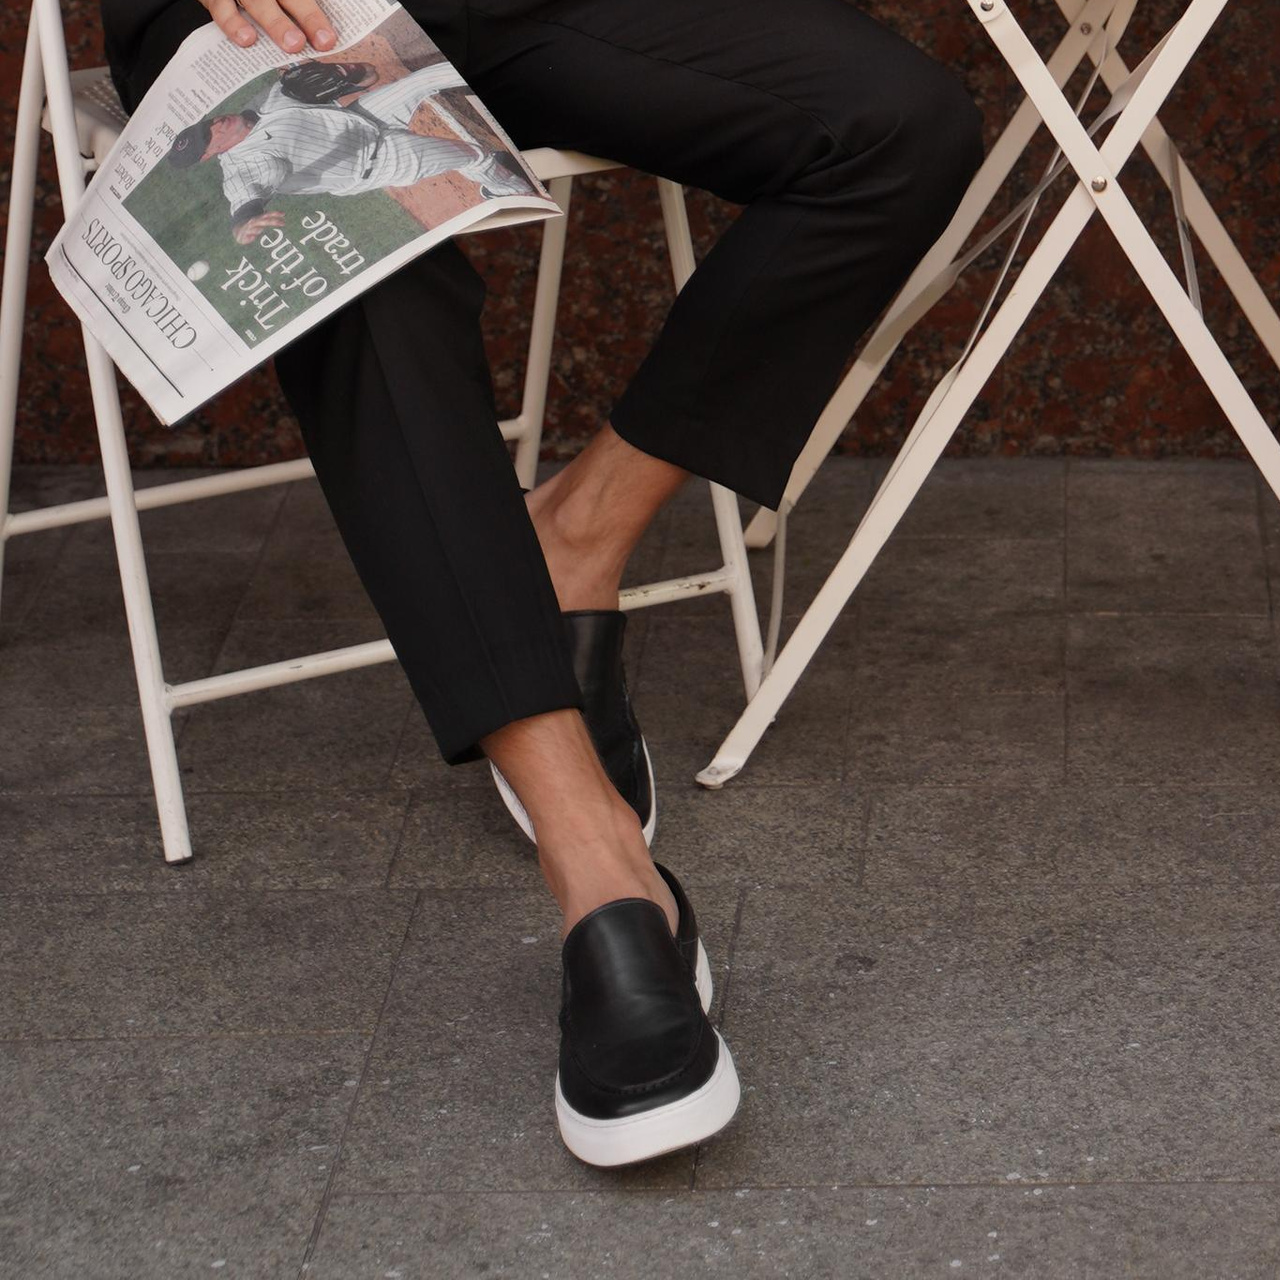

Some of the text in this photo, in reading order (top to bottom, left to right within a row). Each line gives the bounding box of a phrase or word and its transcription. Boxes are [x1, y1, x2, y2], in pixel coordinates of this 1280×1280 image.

[81, 218, 136, 280] SPORTS
[260, 229, 327, 297] of the
[299, 211, 365, 275] trade
[124, 269, 197, 349] CHICAGO
[221, 256, 290, 330] Trick
